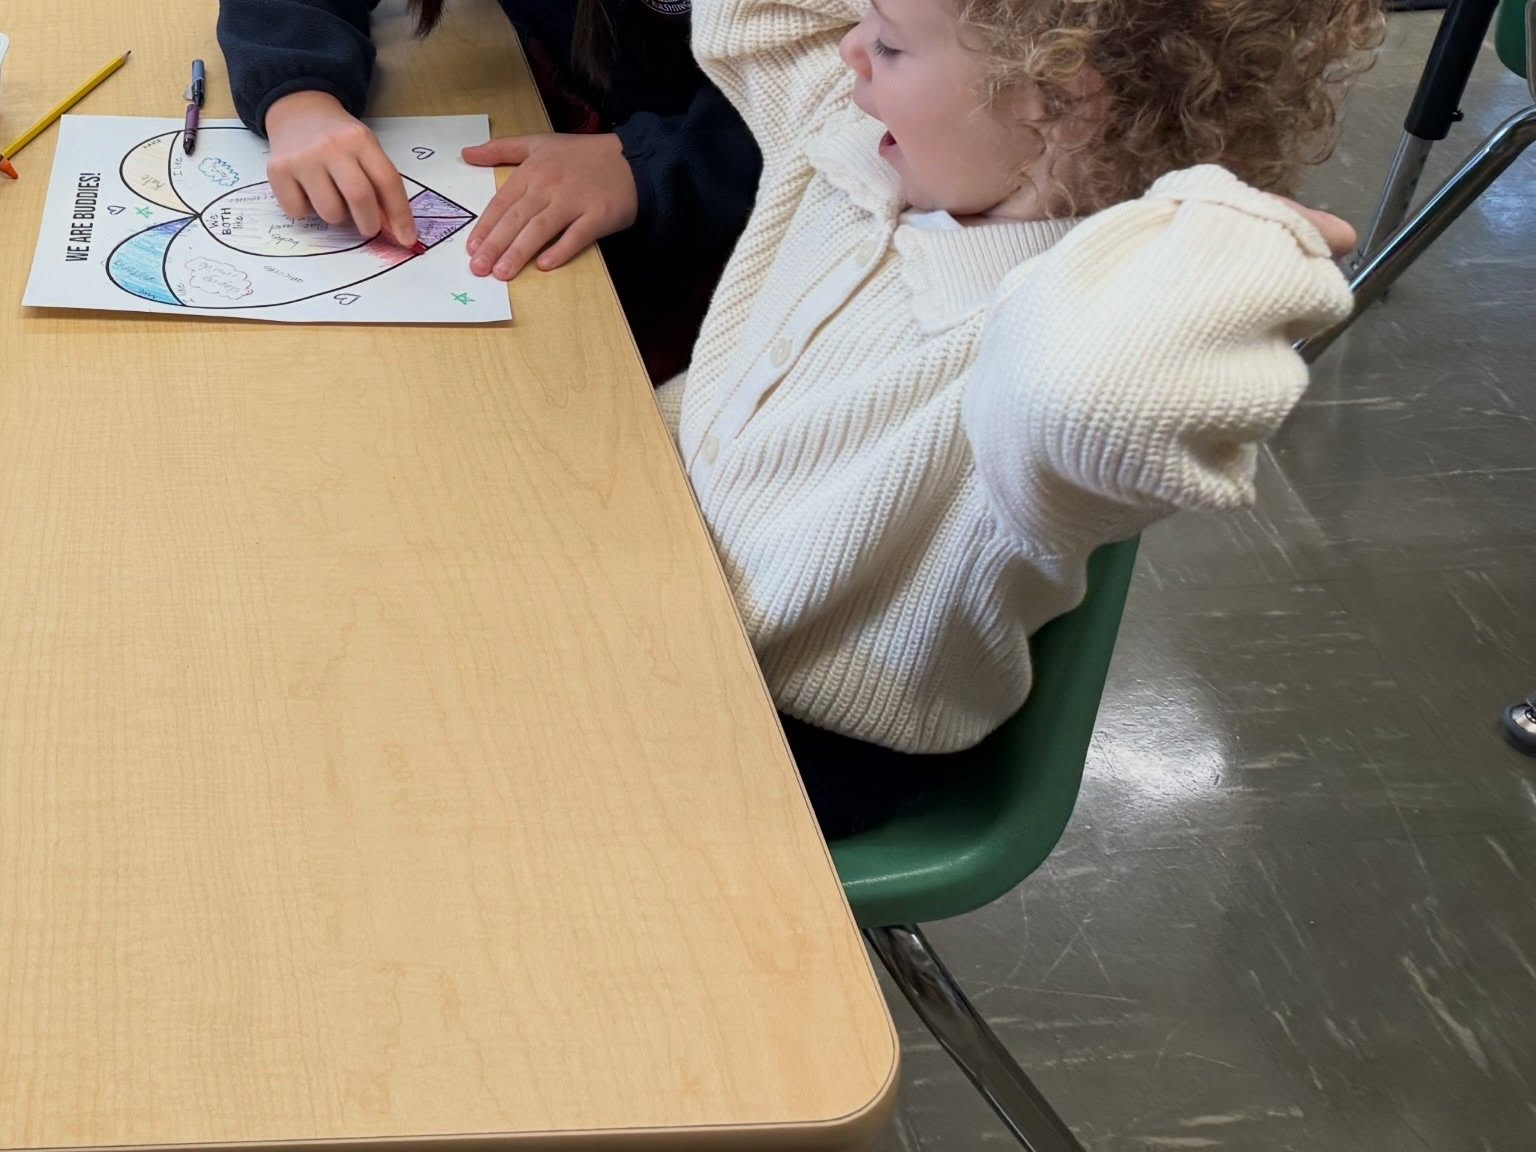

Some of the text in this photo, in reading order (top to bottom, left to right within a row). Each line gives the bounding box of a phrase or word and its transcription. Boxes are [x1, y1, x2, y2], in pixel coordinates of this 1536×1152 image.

[65, 172, 101, 262] WE ARE BUDDIES!
[221, 207, 232, 235] BOTH
